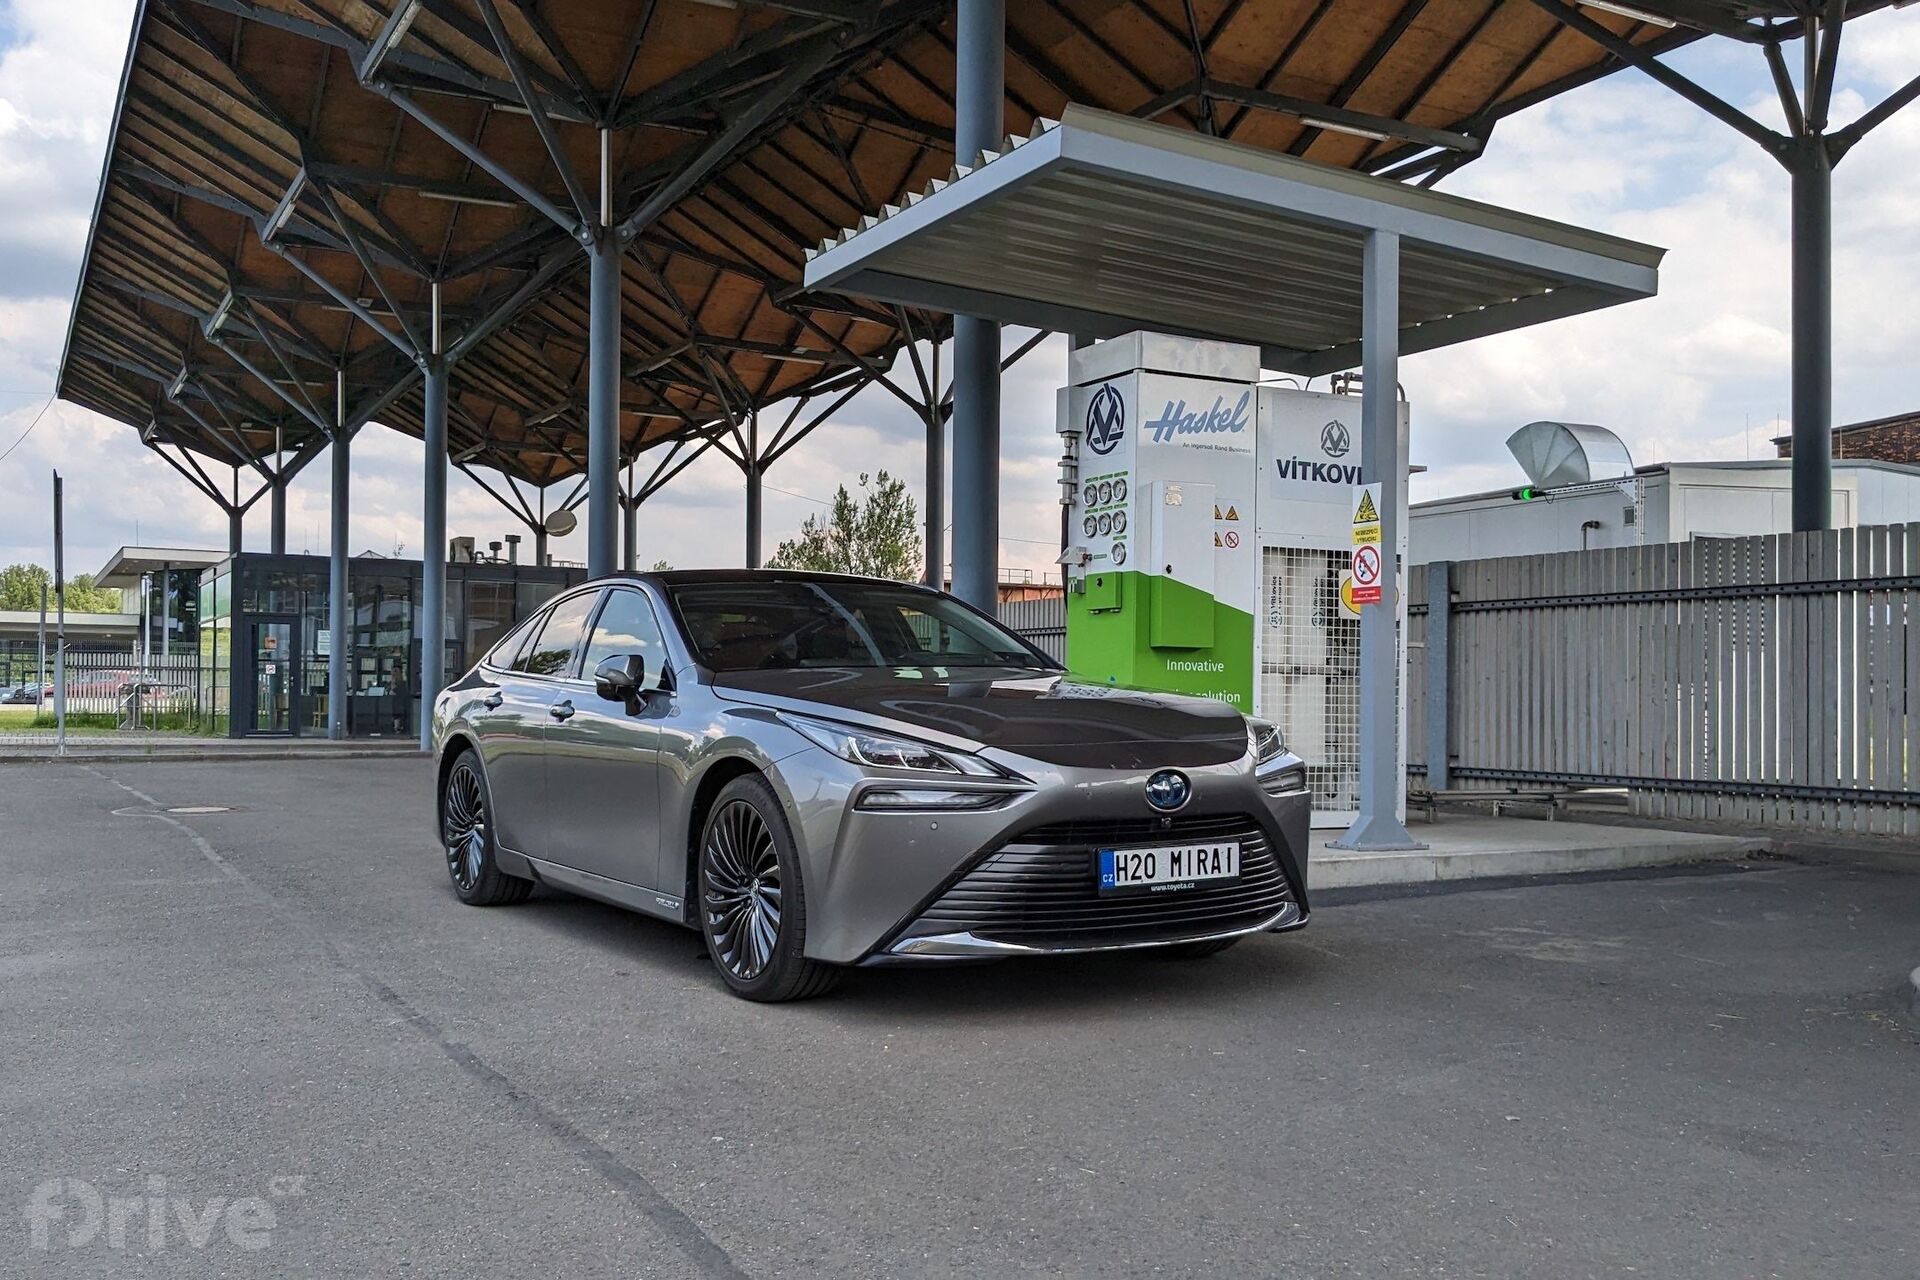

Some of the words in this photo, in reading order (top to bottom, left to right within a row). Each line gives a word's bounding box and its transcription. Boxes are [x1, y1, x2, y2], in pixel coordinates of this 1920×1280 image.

[1144, 390, 1250, 443] Haskel
[1166, 658, 1224, 672] Innovative
[1195, 689, 1241, 703] olution
[1102, 874, 1113, 883] CZ
[1151, 882, 1195, 891] www.toyota.cz
